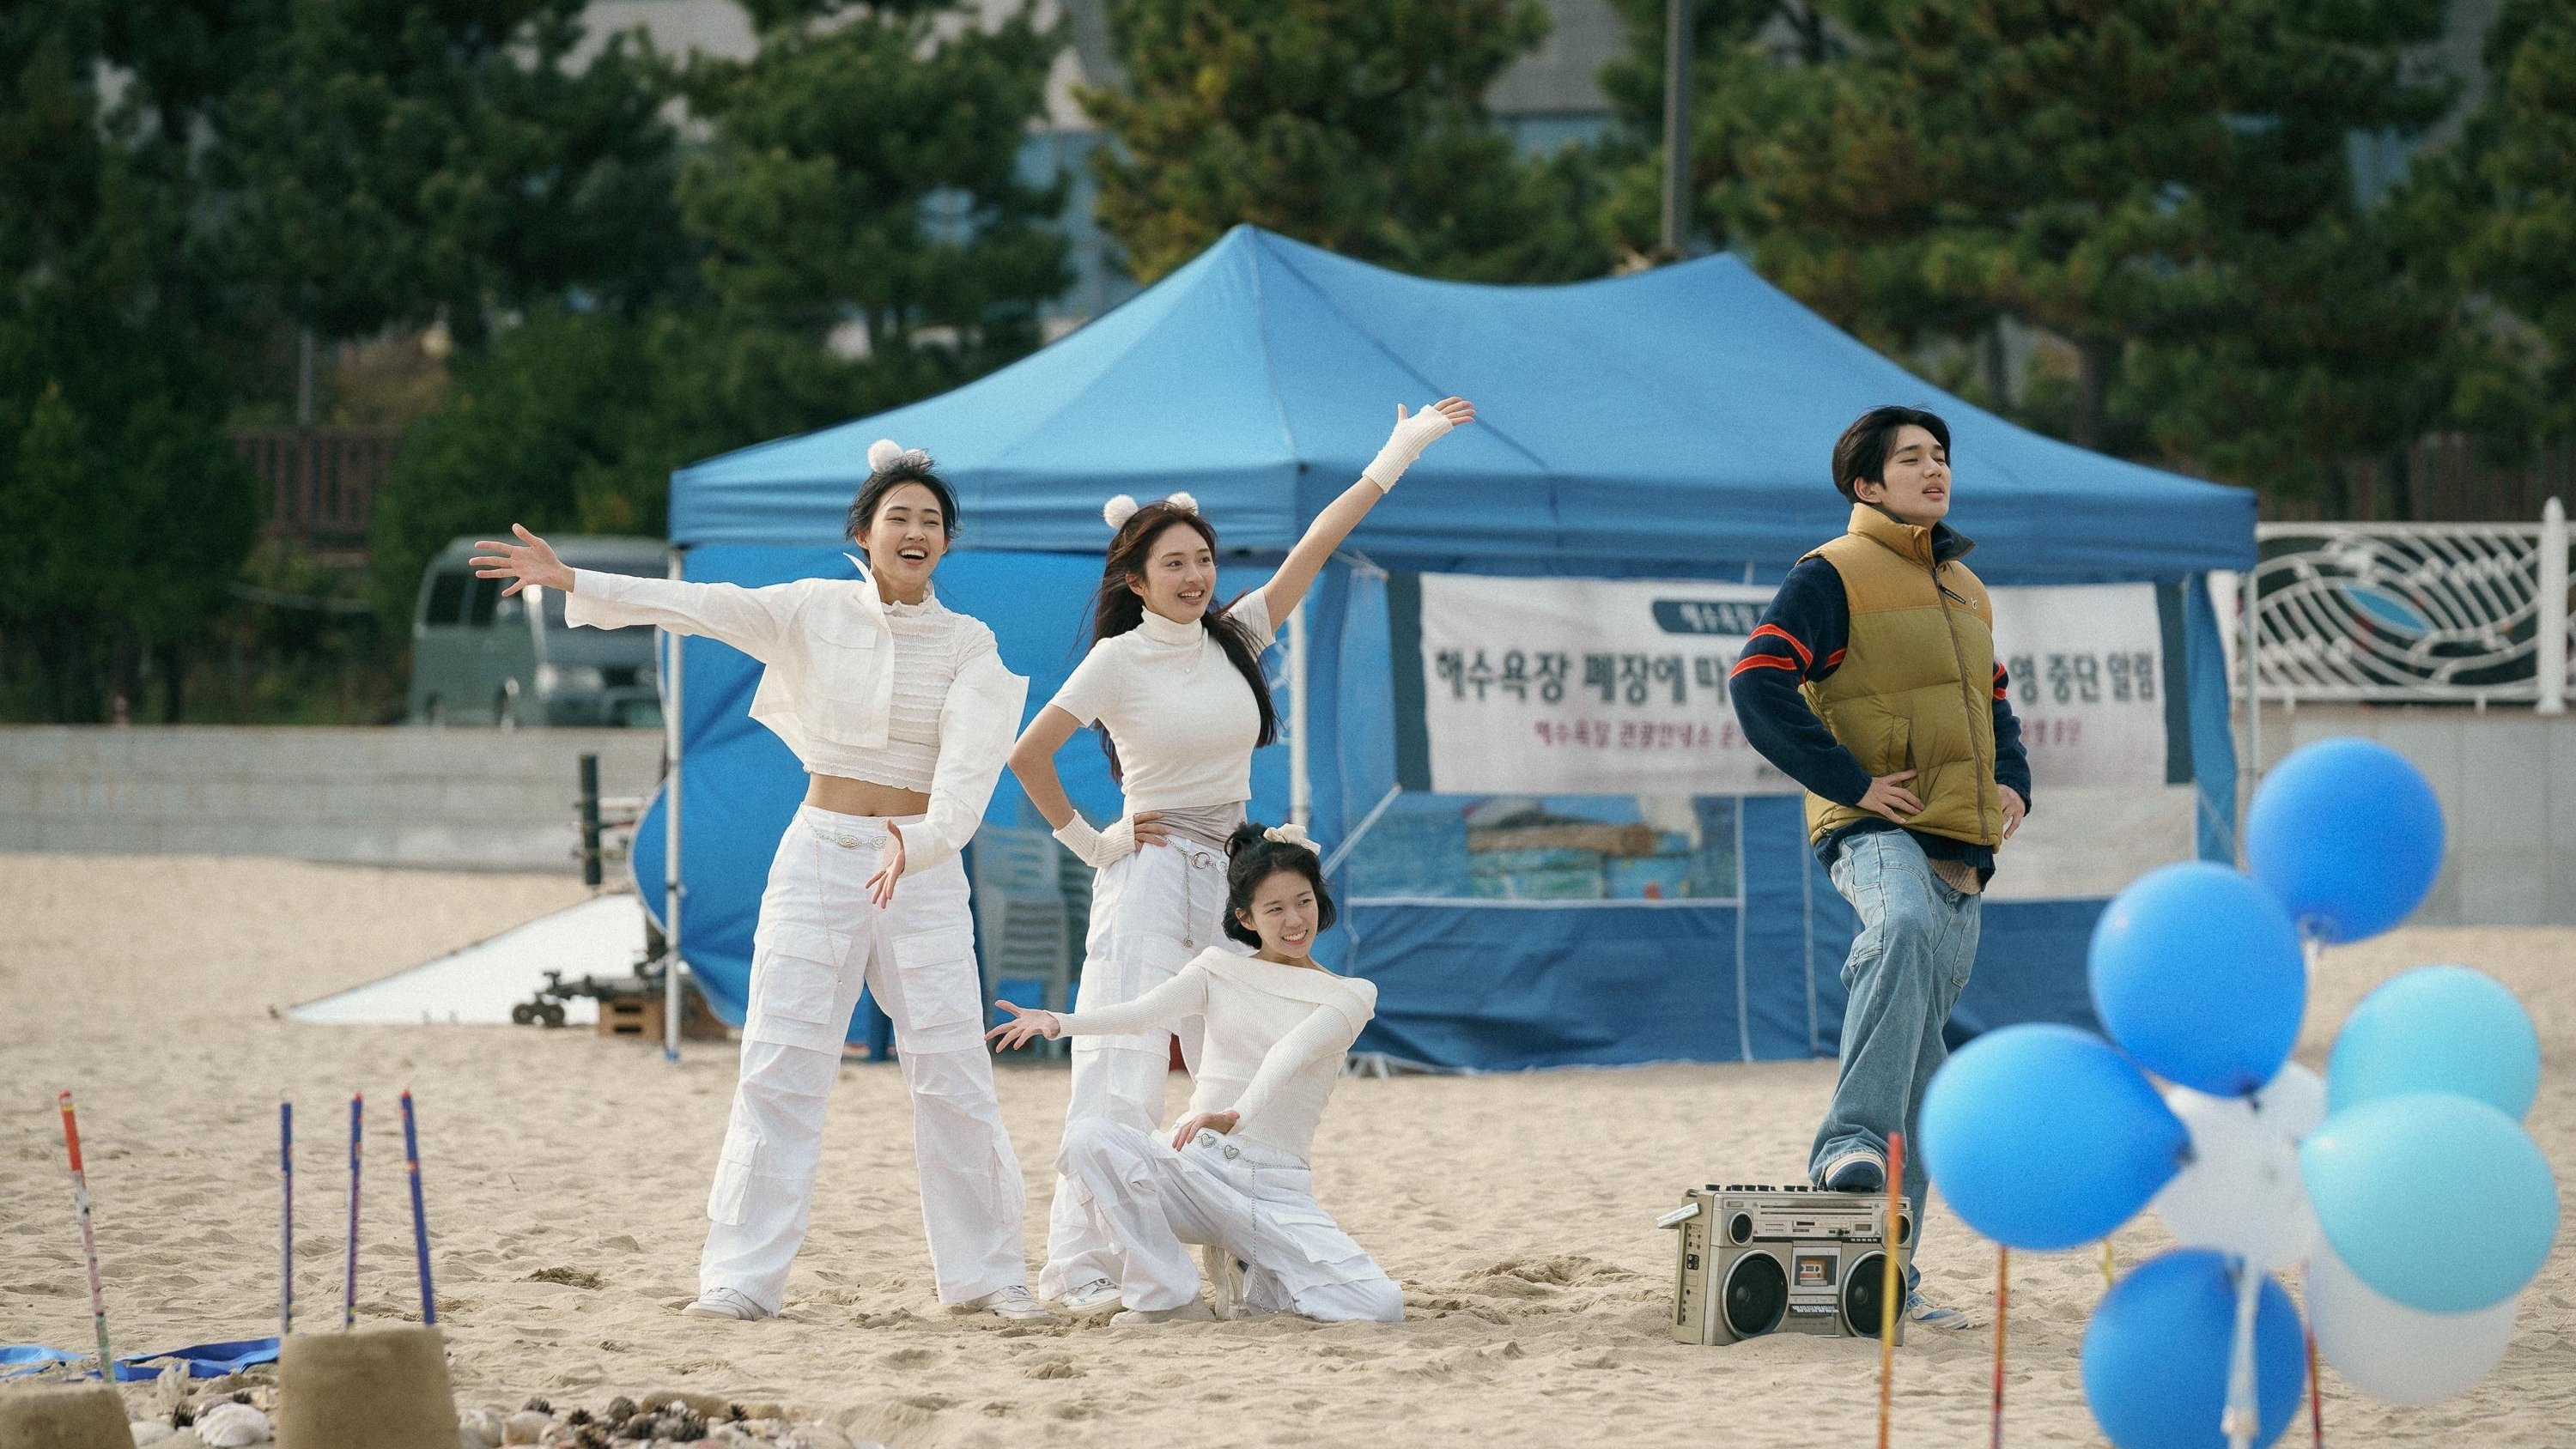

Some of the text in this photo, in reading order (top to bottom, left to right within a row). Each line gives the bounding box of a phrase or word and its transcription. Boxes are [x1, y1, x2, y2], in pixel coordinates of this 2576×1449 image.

[1436, 648, 2154, 706] 해수욕장 폐장에 따 영 중단 알림
